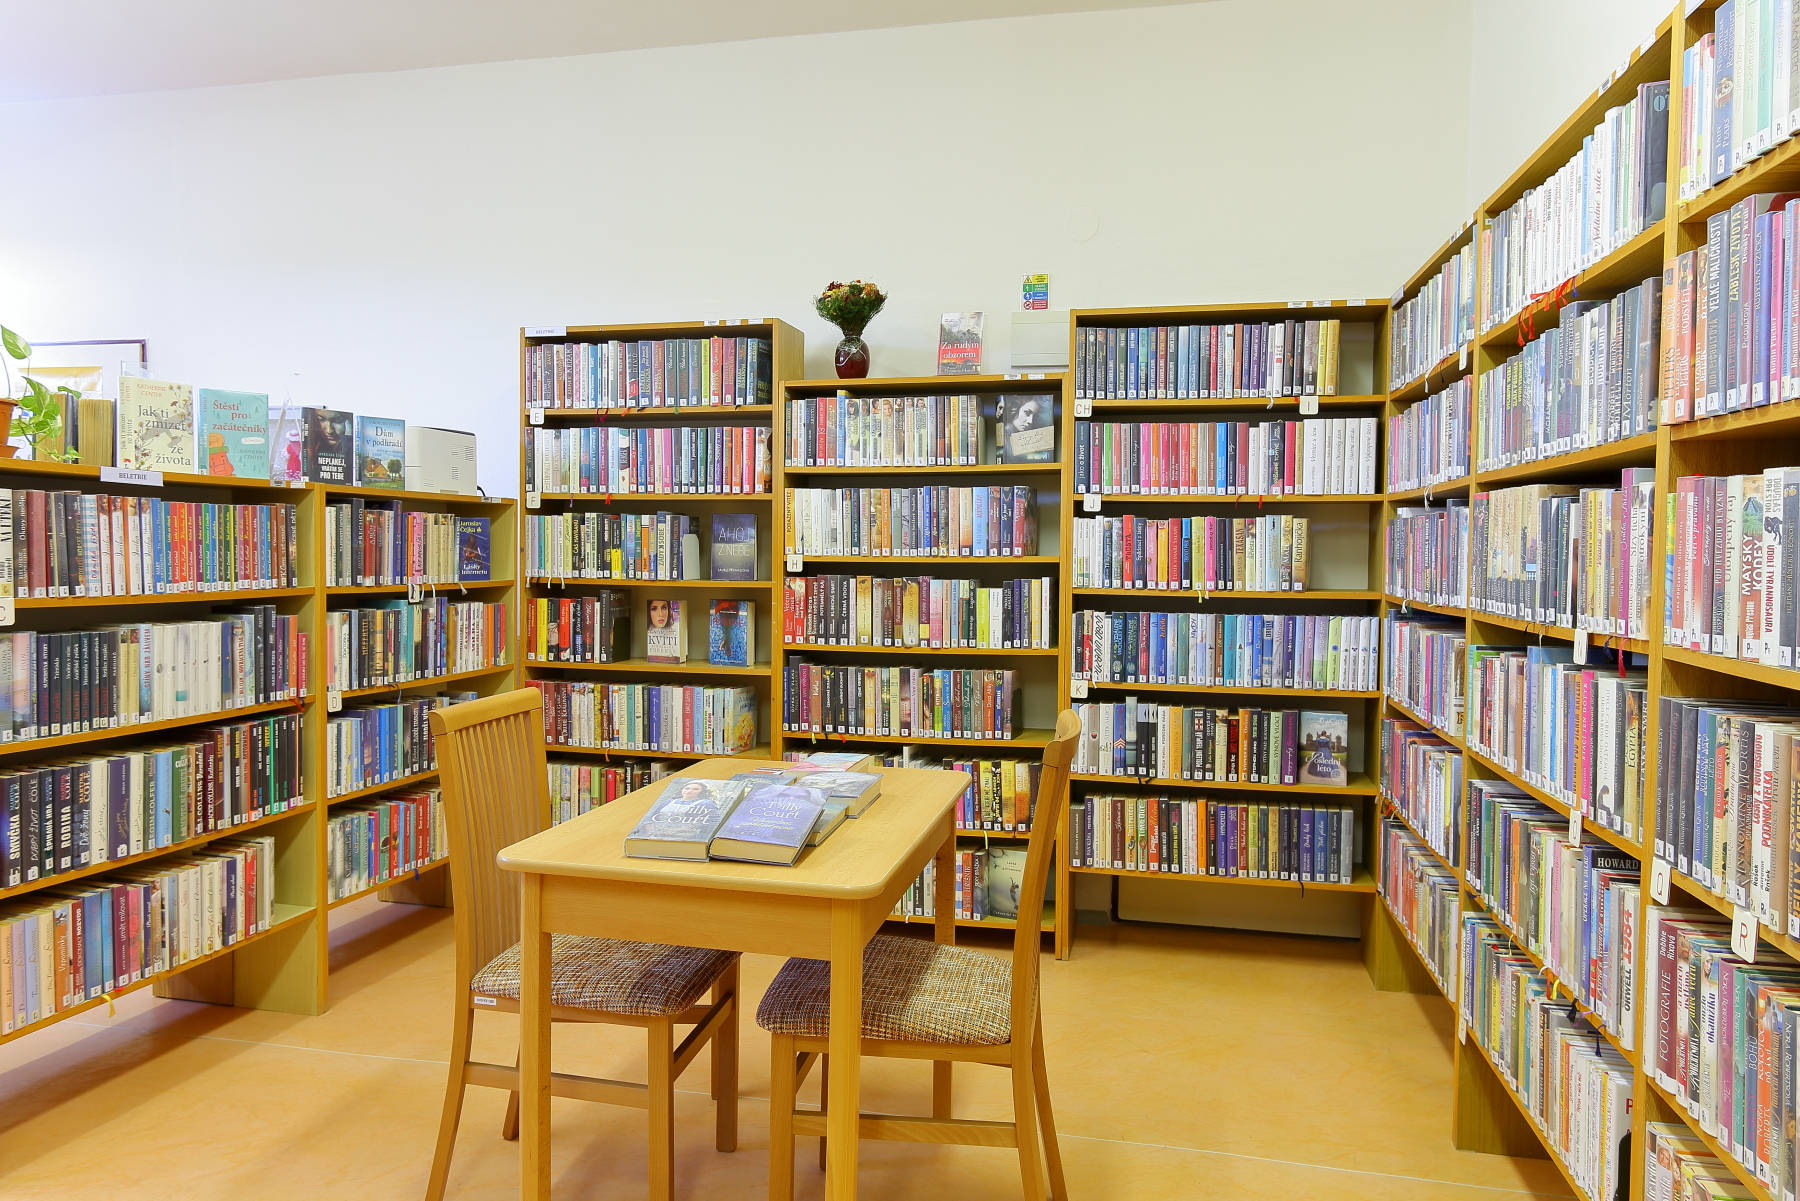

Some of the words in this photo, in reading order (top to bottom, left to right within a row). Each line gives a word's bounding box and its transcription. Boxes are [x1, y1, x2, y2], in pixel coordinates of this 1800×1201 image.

[1736, 44, 1744, 64] ženy
[1722, 117, 1730, 148] PEARS
[1707, 221, 1721, 279] MALIČKOSTI
[1709, 282, 1720, 312] VELKÉ
[954, 341, 979, 350] rudým
[943, 351, 975, 359] obzorem
[1664, 347, 1675, 398] PETERS
[1709, 372, 1717, 388] JODI
[1623, 367, 1633, 418] Morton
[138, 405, 157, 417] Jak
[161, 409, 169, 417] ti
[213, 400, 239, 410] Štěstí
[1075, 406, 1090, 415] CH
[534, 412, 539, 422] E
[146, 420, 186, 431] zmizet
[213, 423, 267, 435] začátečníky
[375, 427, 393, 437] Dům
[372, 439, 402, 448] podhradí
[171, 446, 183, 454] ze
[156, 456, 191, 465] života
[320, 472, 330, 480] PRO
[530, 496, 536, 504] F
[1772, 477, 1782, 512] DOUGLAS
[1089, 500, 1095, 510] J
[19, 519, 27, 540] Okovy
[1294, 522, 1304, 563] Ranhojička
[1630, 541, 1638, 557] Slzy
[791, 559, 798, 570] H
[1765, 571, 1774, 633] TYRANNOSAURA
[1075, 685, 1082, 695] K
[332, 696, 337, 708] D
[1628, 727, 1636, 768] EGYPTA
[1305, 752, 1340, 765] Poslední
[1737, 730, 1749, 788] MORTIS
[673, 805, 713, 814] Dilly
[768, 801, 802, 811] Dilly
[651, 813, 710, 825] Court
[749, 807, 800, 819] Court
[61, 805, 71, 848] RODINA
[1738, 793, 1747, 851] NOMINE
[9, 814, 19, 860] SMYČKA
[1598, 857, 1639, 869] HOWARD
[1582, 877, 1588, 888] NA
[1621, 909, 1632, 964] 1984
[1739, 923, 1747, 952] R
[1660, 970, 1671, 1061] FOTOGRAFIE
